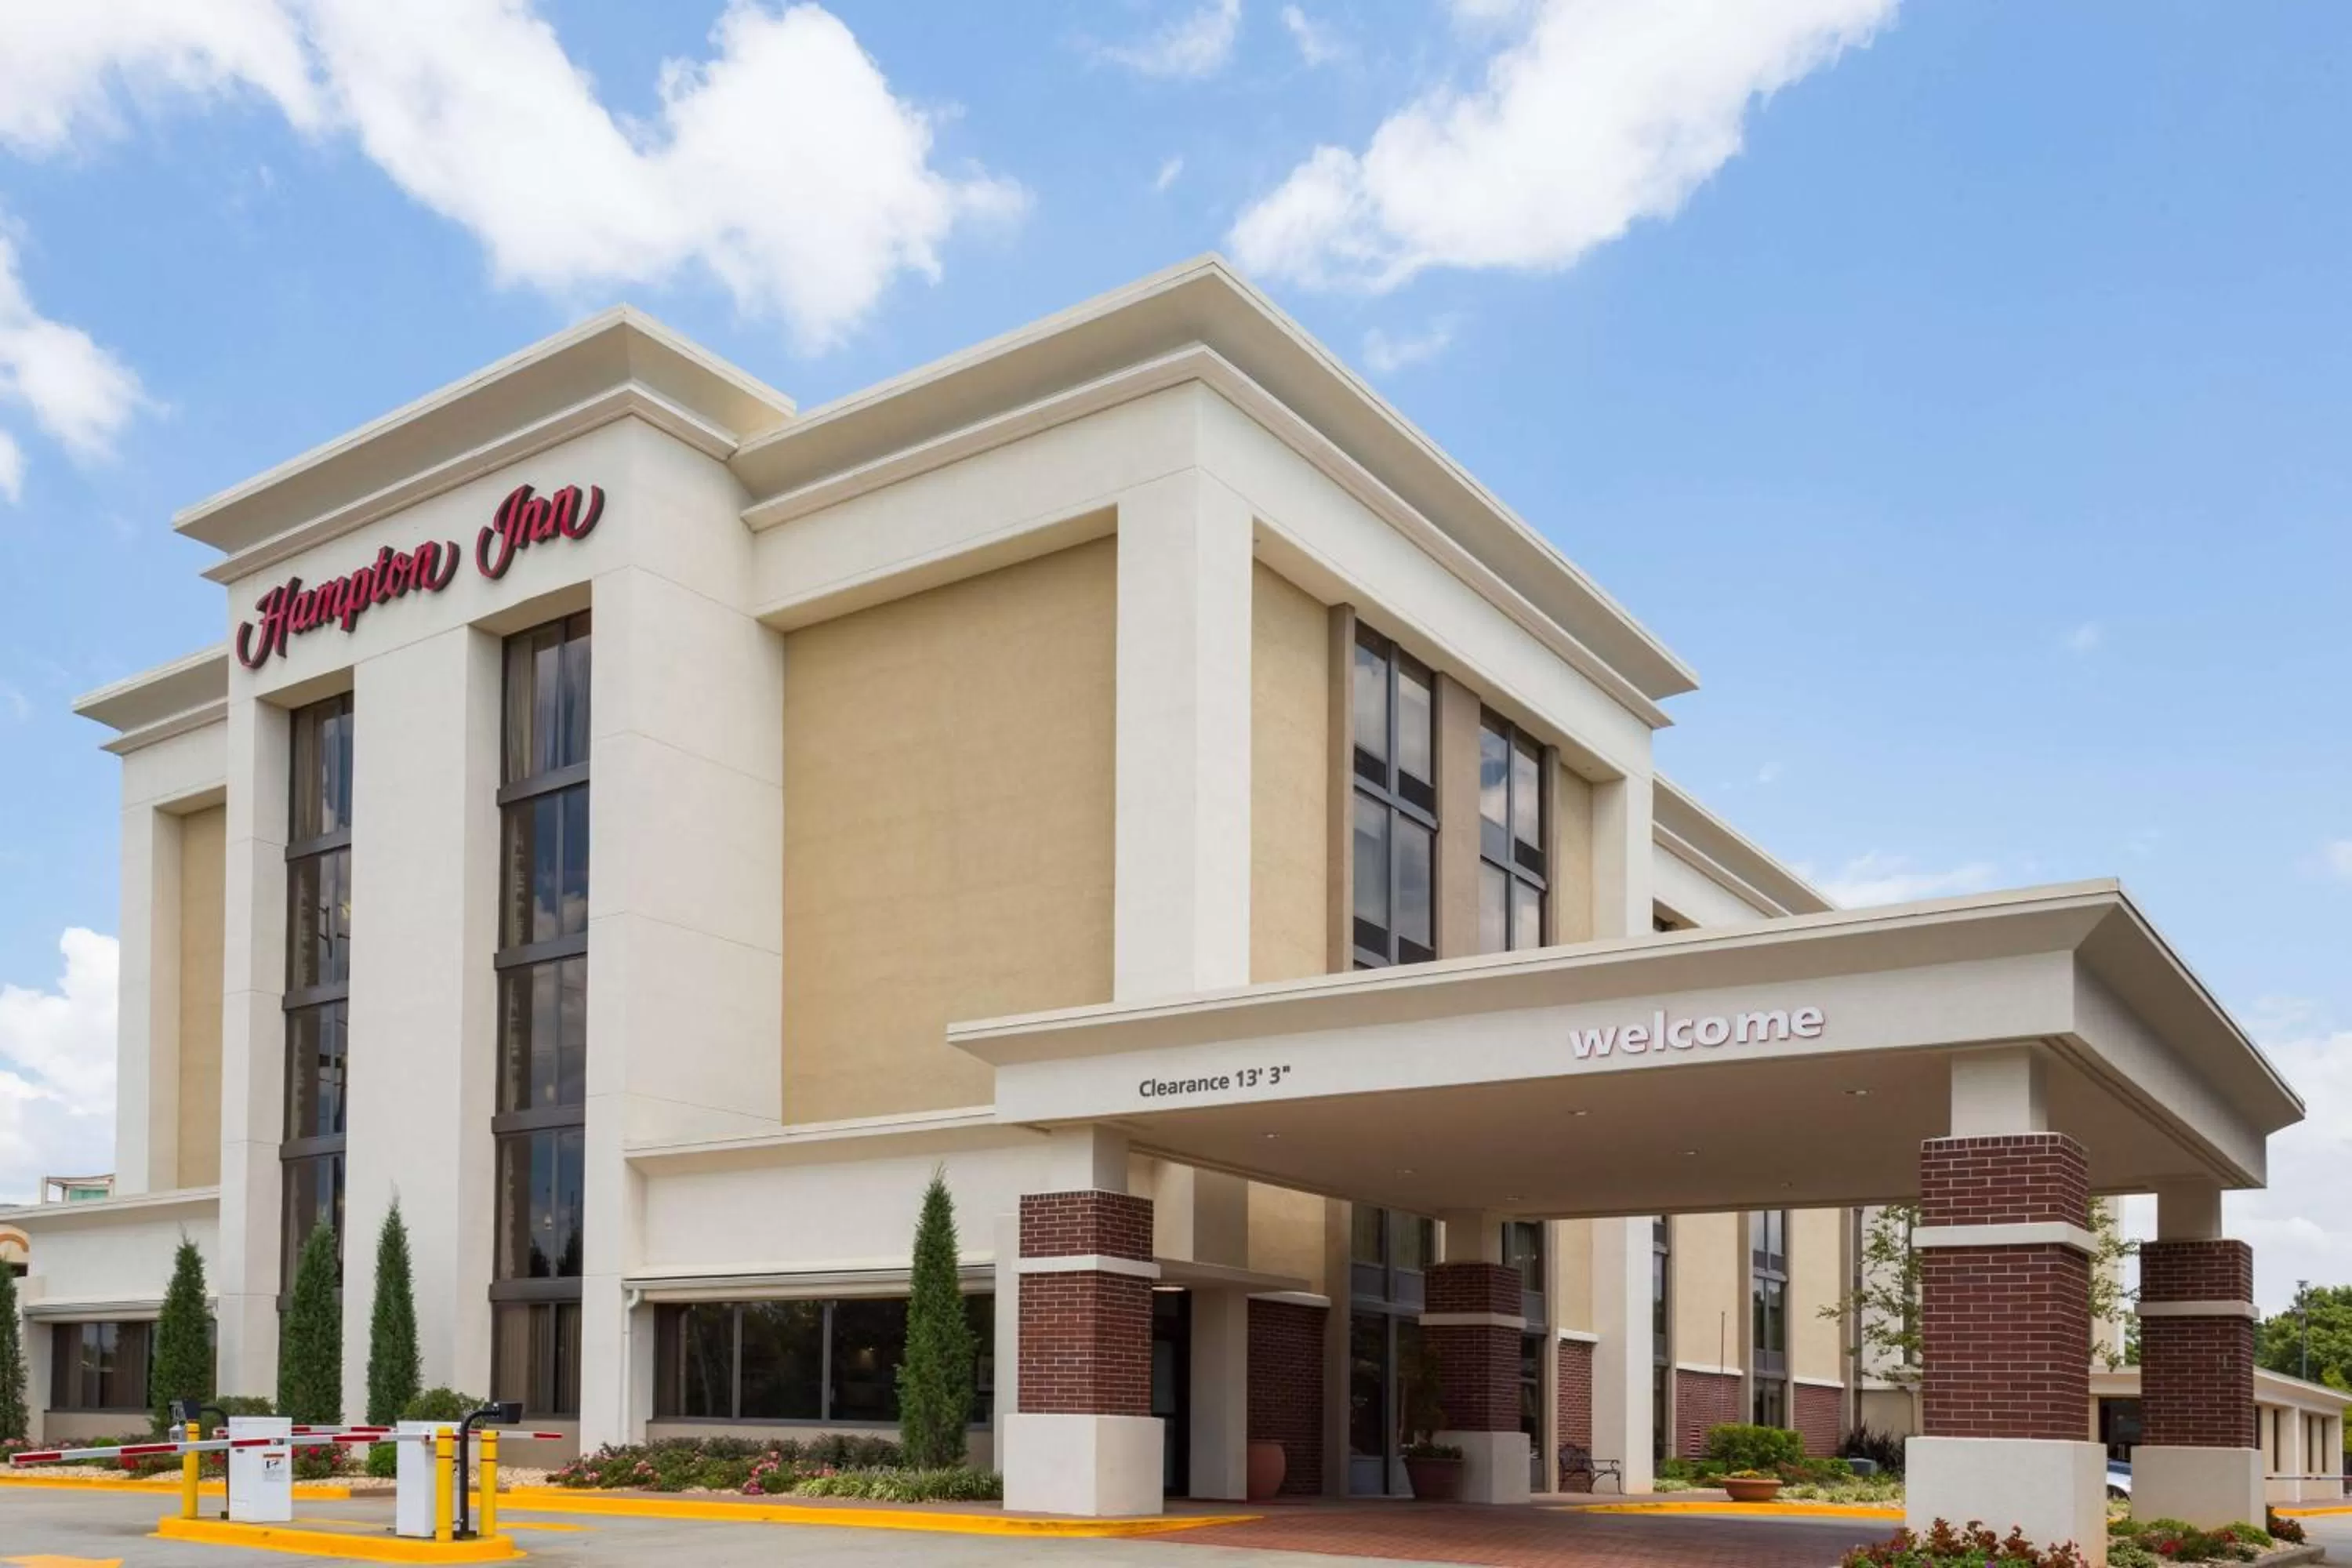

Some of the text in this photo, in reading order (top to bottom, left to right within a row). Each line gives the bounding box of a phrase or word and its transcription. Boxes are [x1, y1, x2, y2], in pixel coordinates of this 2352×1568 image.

[236, 484, 604, 669] Hampton Inn
[1569, 1005, 1825, 1058] welcome
[1139, 1065, 1290, 1097] Clearance 13' 3"
